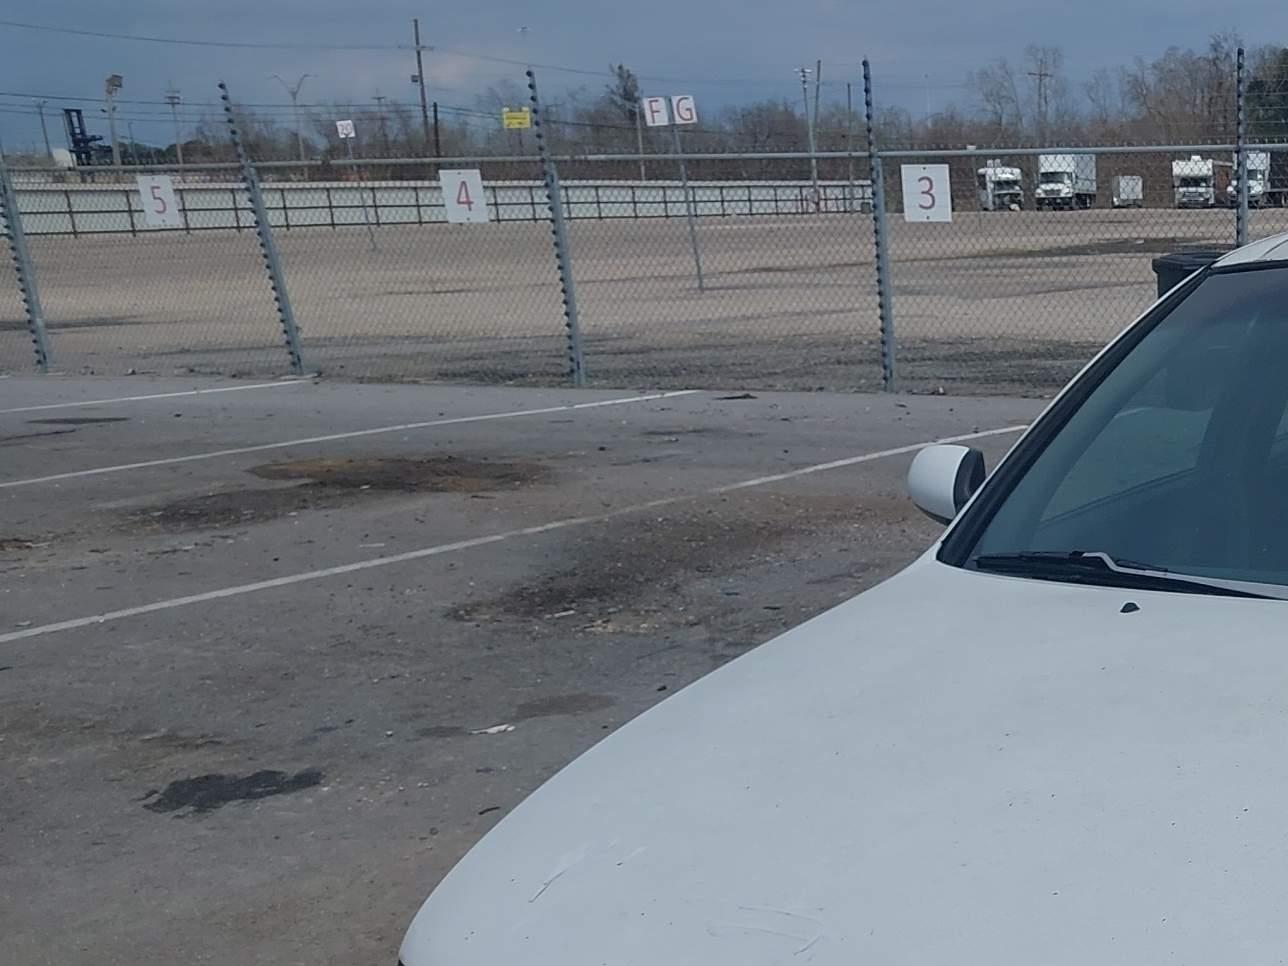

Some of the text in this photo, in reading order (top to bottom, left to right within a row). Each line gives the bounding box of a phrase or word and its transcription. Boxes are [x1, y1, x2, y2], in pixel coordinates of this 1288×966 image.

[648, 99, 660, 124] F
[676, 96, 693, 121] G
[151, 186, 167, 214] 5
[456, 181, 474, 211] 4
[918, 176, 935, 210] 3
